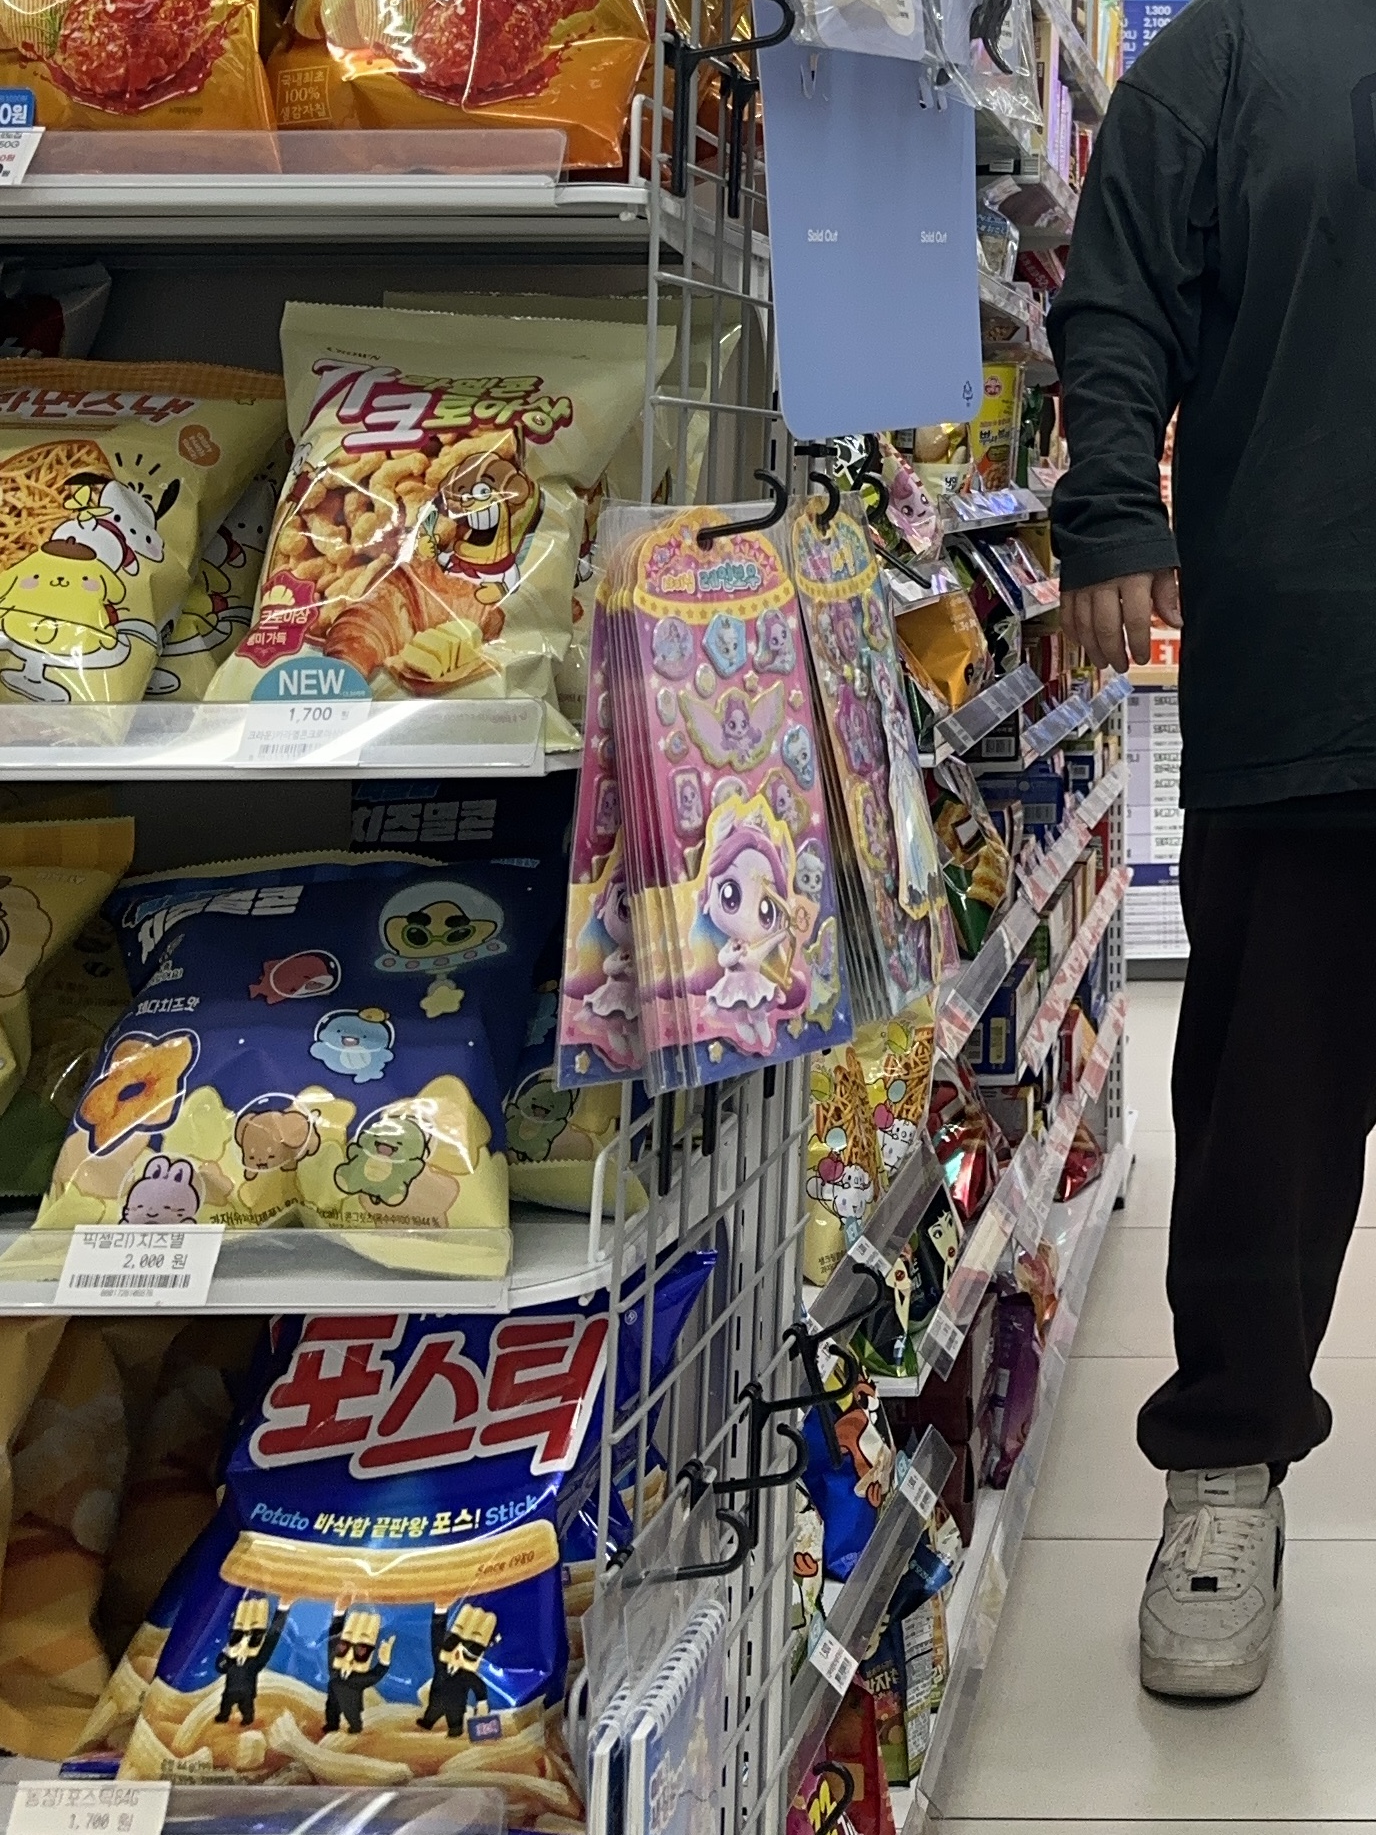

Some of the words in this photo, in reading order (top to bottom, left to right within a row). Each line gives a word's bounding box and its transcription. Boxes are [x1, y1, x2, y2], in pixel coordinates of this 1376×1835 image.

[281, 71, 325, 85] 국내최초
[284, 86, 320, 102] 100%
[807, 229, 823, 243] Sold
[825, 230, 838, 243] Out
[279, 669, 344, 696] NEW
[289, 707, 332, 722] 1,700
[123, 1254, 164, 1269] 2,000
[172, 1254, 187, 1269] 원
[250, 1315, 611, 1479] 포스틱
[251, 1502, 309, 1531] Potato
[430, 1508, 480, 1536] 포스!
[486, 1495, 538, 1527] Stick
[69, 1812, 110, 1830] 1,700
